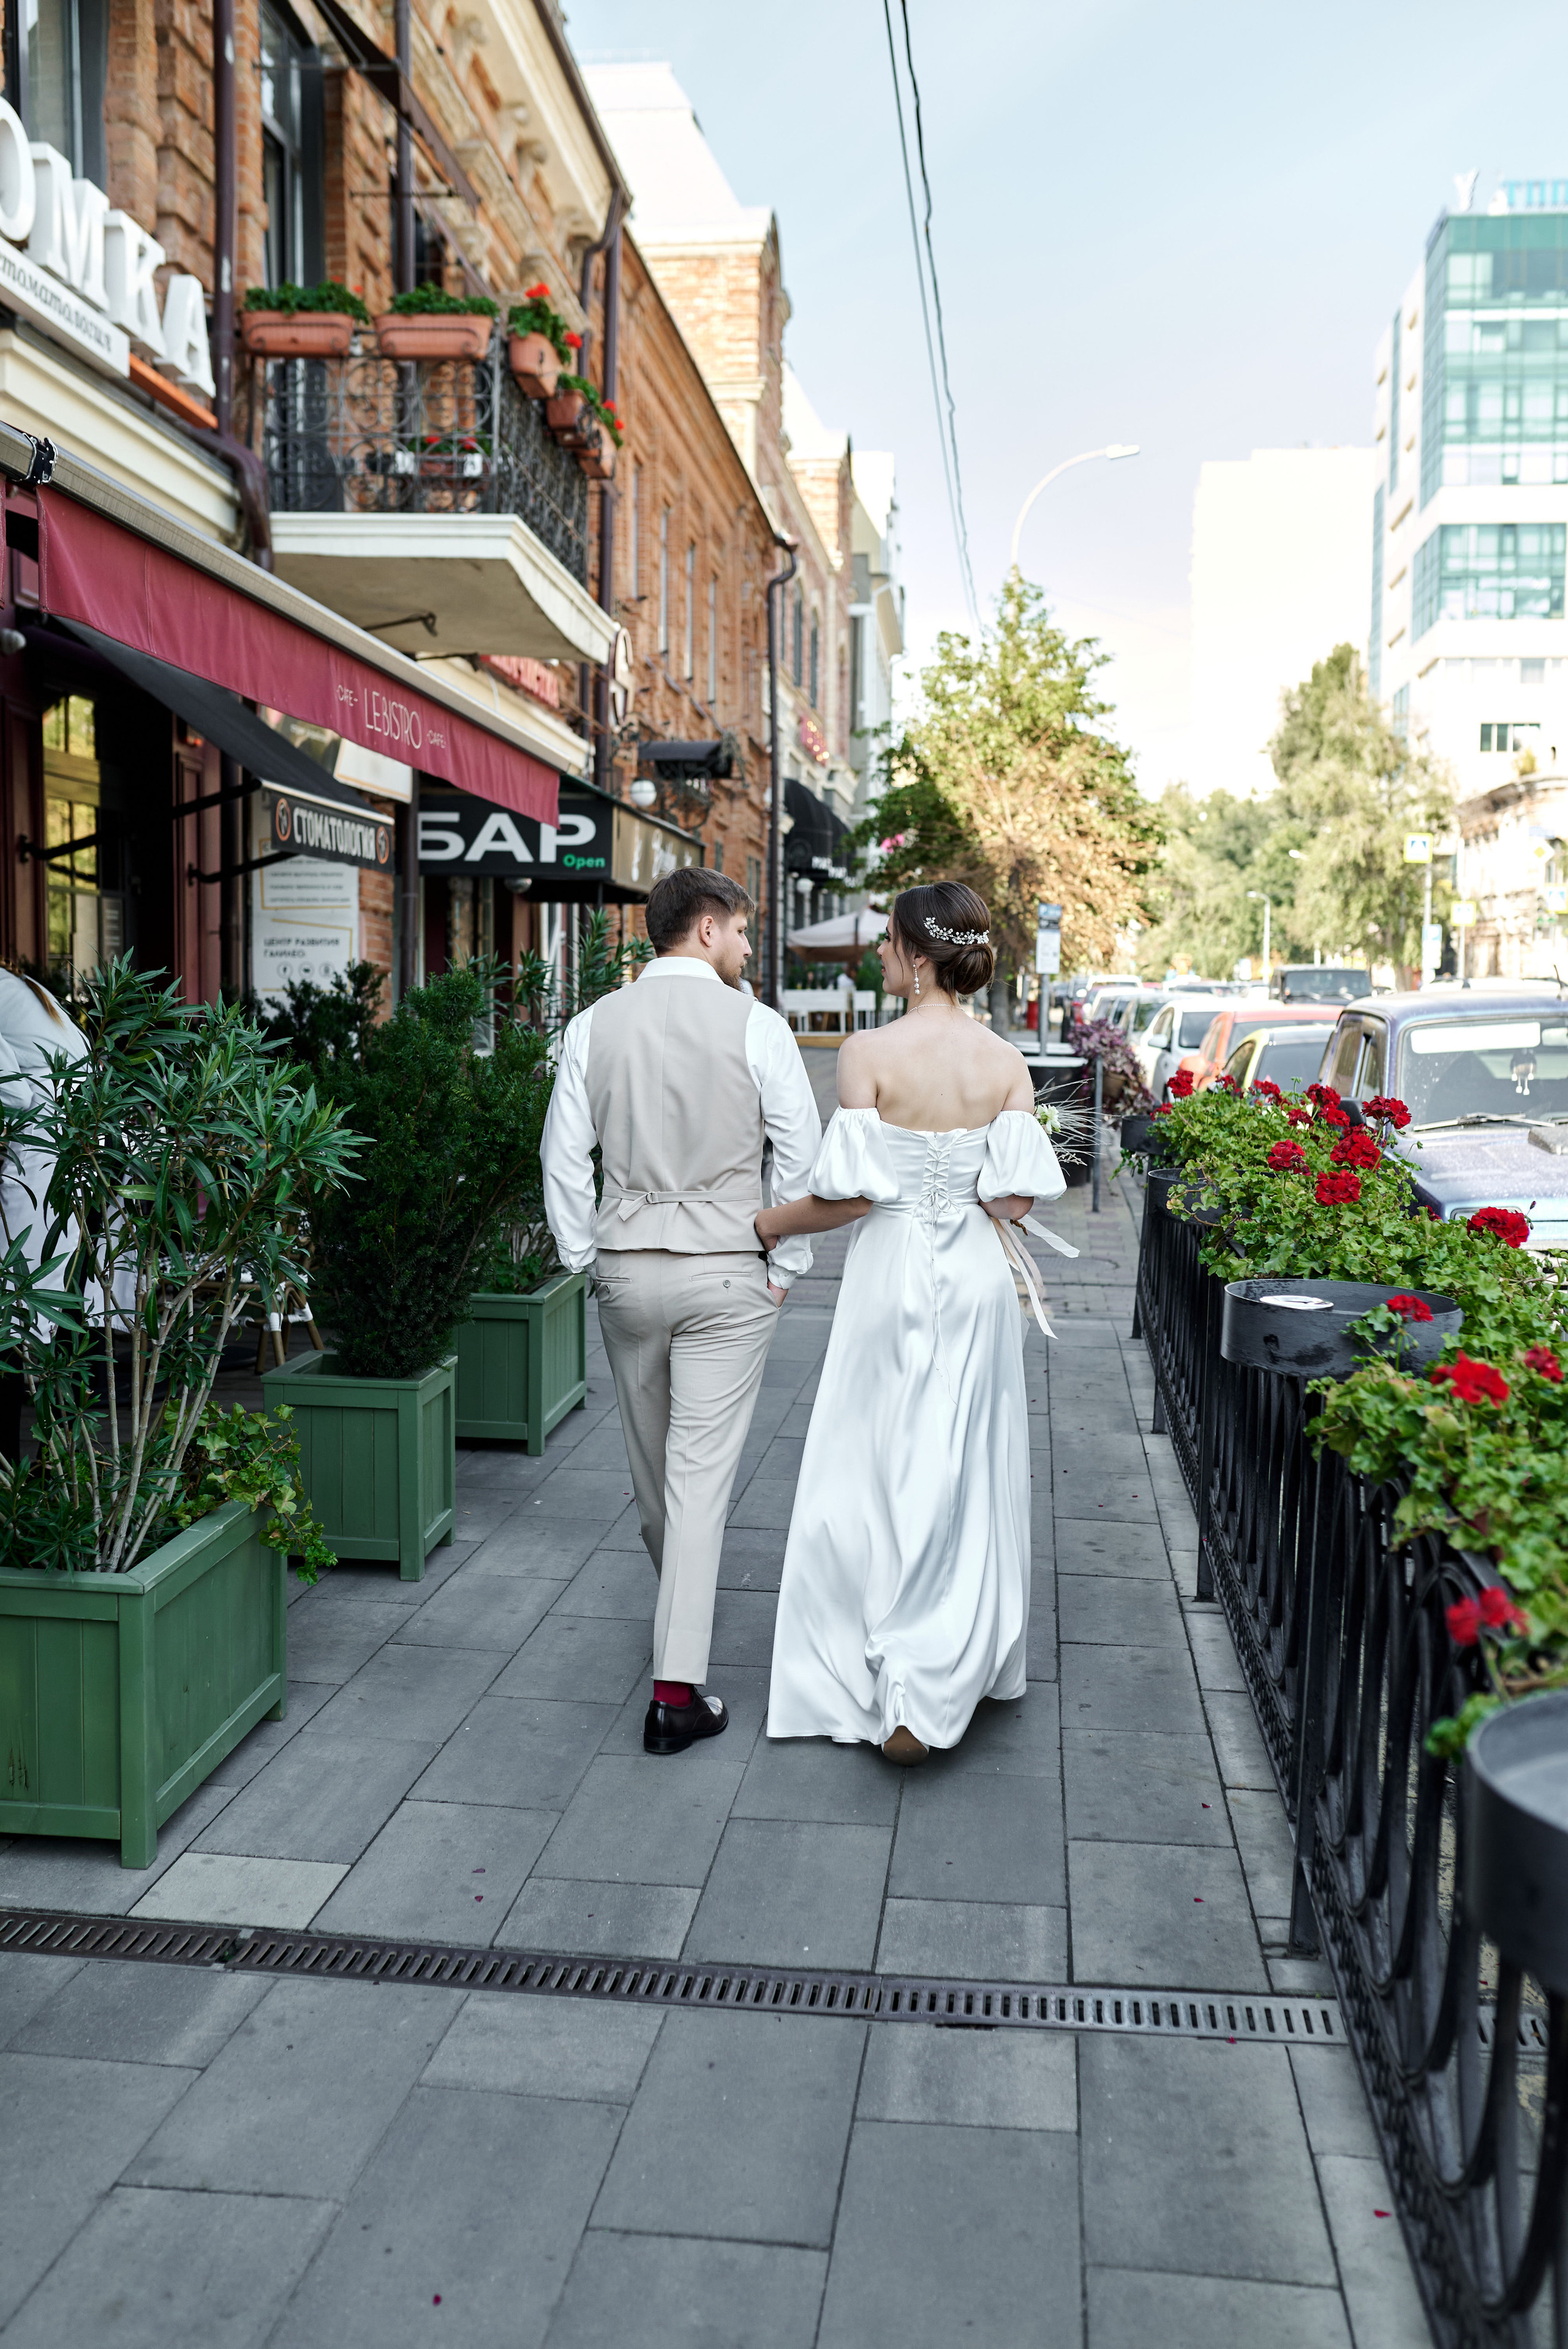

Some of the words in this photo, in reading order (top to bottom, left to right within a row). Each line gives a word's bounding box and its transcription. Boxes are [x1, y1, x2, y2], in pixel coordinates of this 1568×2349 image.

[0, 252, 112, 353] томатология
[293, 806, 376, 861] СТОМАТОЛОГИЯ
[417, 812, 597, 863] БАР
[562, 853, 606, 870] Open
